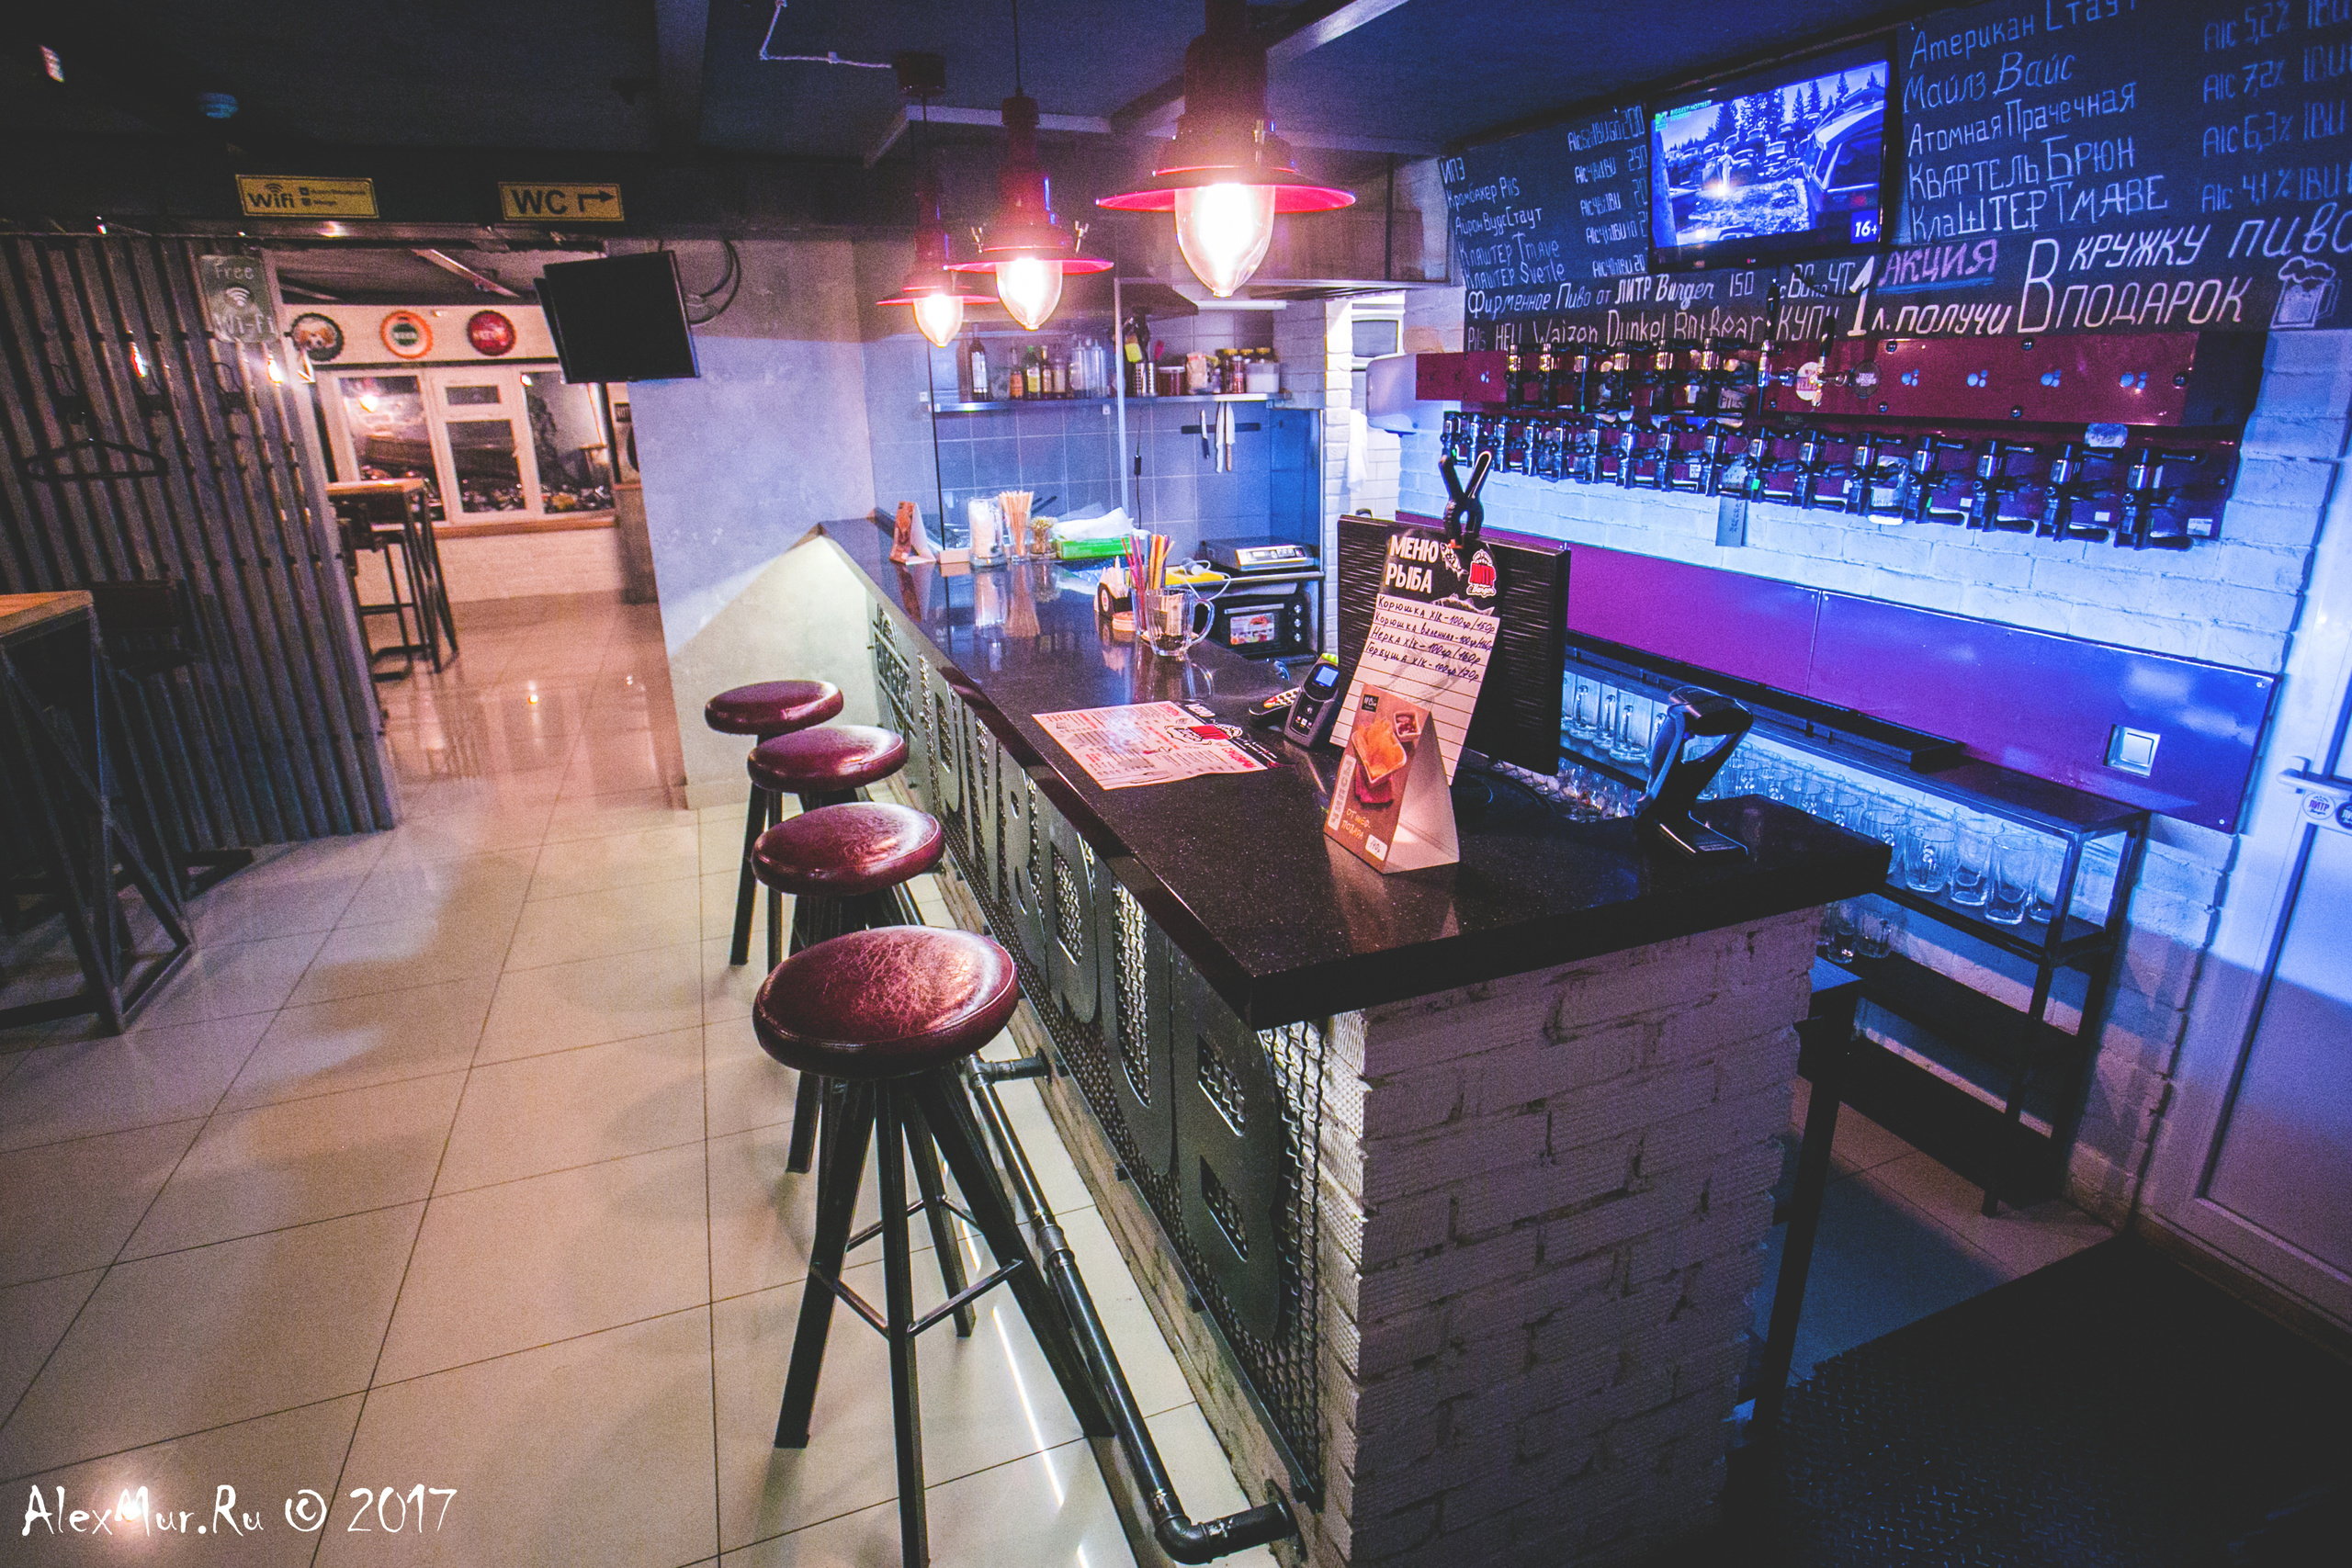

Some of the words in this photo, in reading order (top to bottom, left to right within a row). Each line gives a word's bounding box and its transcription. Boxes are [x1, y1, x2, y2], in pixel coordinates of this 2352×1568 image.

[1993, 51, 2075, 97] Вайс
[1441, 157, 1465, 184] ИПЭ
[511, 189, 568, 215] WC
[1855, 220, 1877, 238] 16+
[2069, 224, 2211, 271] КРУЖКУ
[1877, 239, 1997, 287] АКЦИЯ
[1468, 290, 1551, 321] Фирменное
[1555, 282, 1591, 310] Пиво
[1614, 276, 1652, 304] ЛИТР
[1655, 274, 1714, 310] Burger
[1729, 271, 1754, 297] 150
[2018, 239, 2059, 333] В
[2055, 277, 2252, 328] ПОДАРОК
[1389, 534, 1440, 563] МЕНЮ
[1385, 563, 1433, 593] РЫБА
